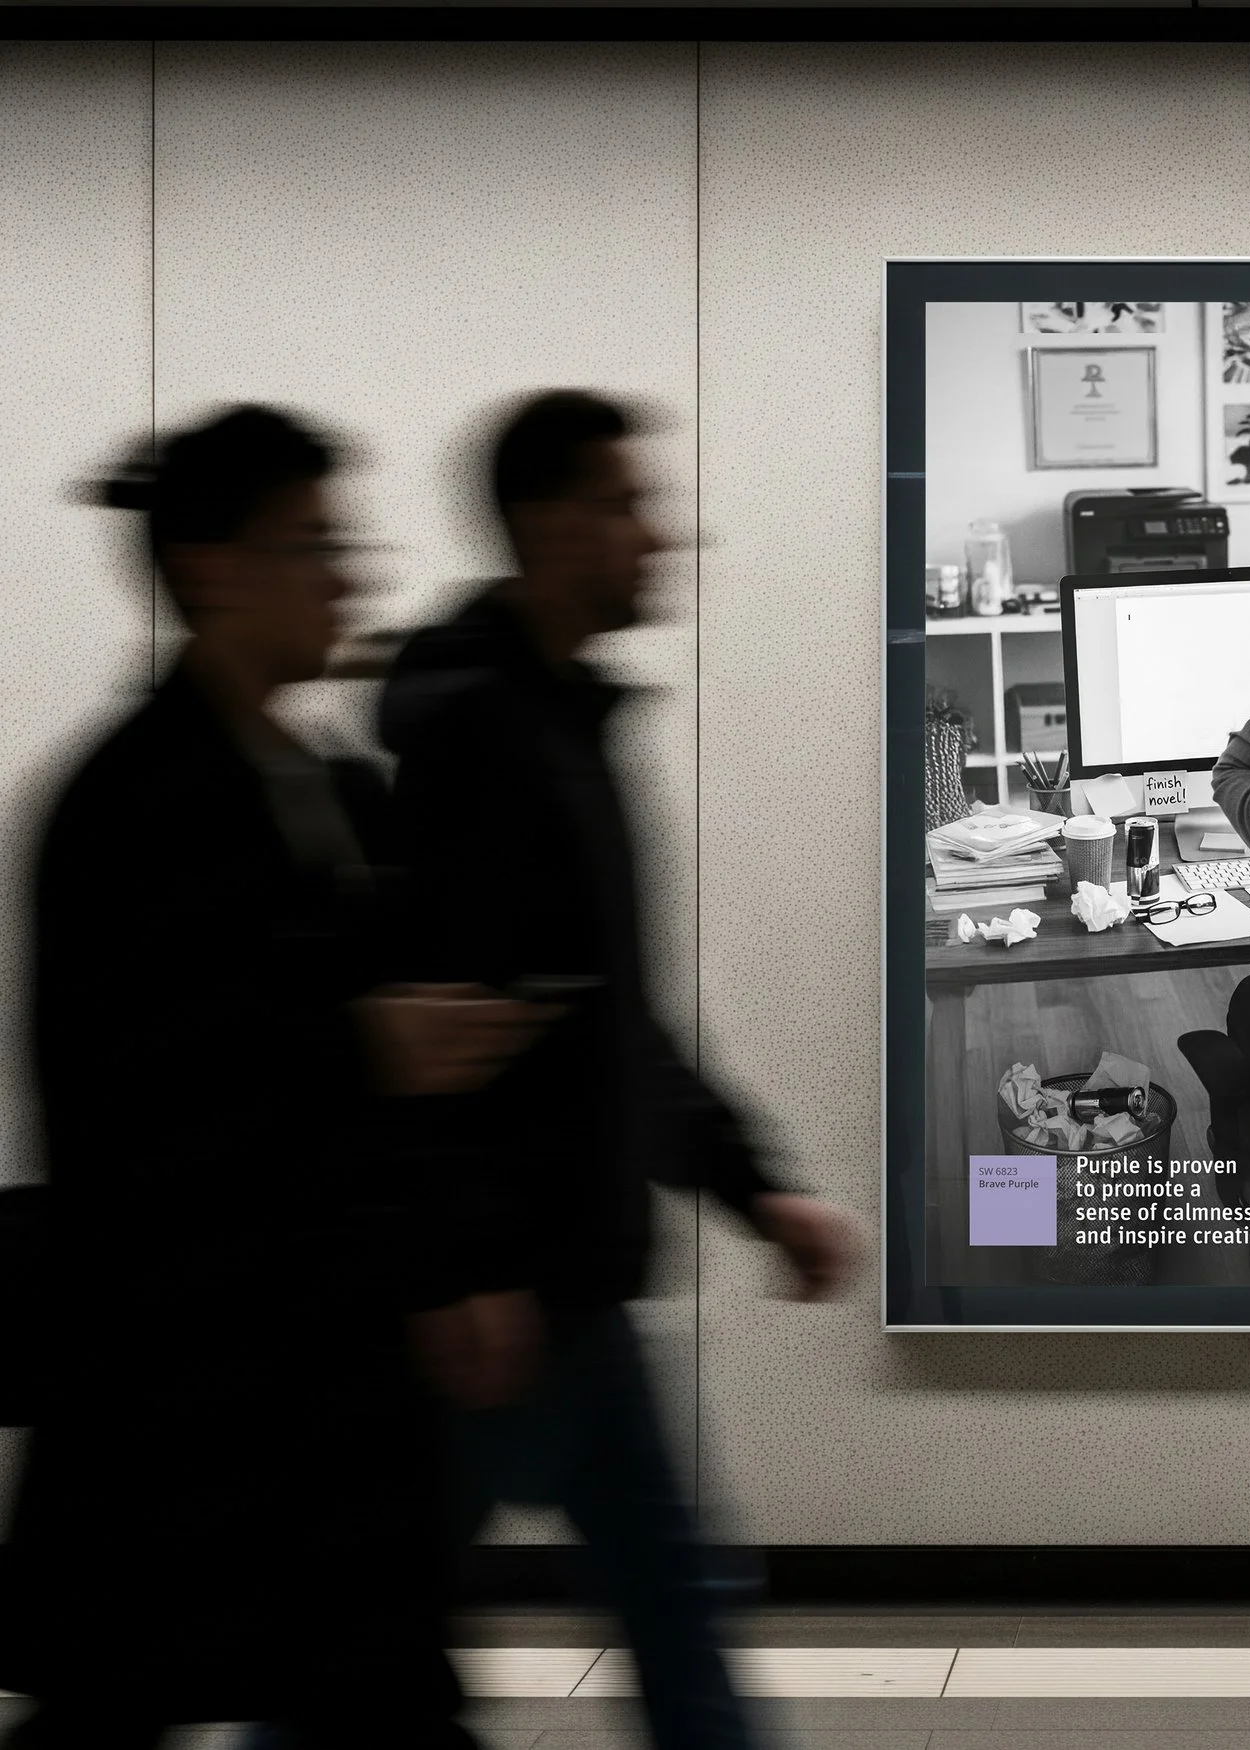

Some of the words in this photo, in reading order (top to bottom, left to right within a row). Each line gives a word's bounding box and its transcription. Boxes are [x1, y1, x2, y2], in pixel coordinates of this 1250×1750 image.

[1146, 775, 1182, 791] finish
[1149, 788, 1186, 806] novel!
[979, 1167, 994, 1176] SW
[995, 1167, 1018, 1176] 6823
[1074, 1155, 1140, 1179] Purple
[1147, 1155, 1163, 1174] is
[1170, 1160, 1238, 1178] proven
[979, 1179, 1006, 1188] Brave
[1008, 1179, 1039, 1190] Purple
[1075, 1180, 1096, 1197] to
[1102, 1180, 1184, 1202] promote
[1190, 1183, 1201, 1198] a
[1075, 1206, 1131, 1221] sense
[1137, 1202, 1158, 1221] of
[1075, 1225, 1112, 1245] and
[1118, 1225, 1187, 1249] inspire
